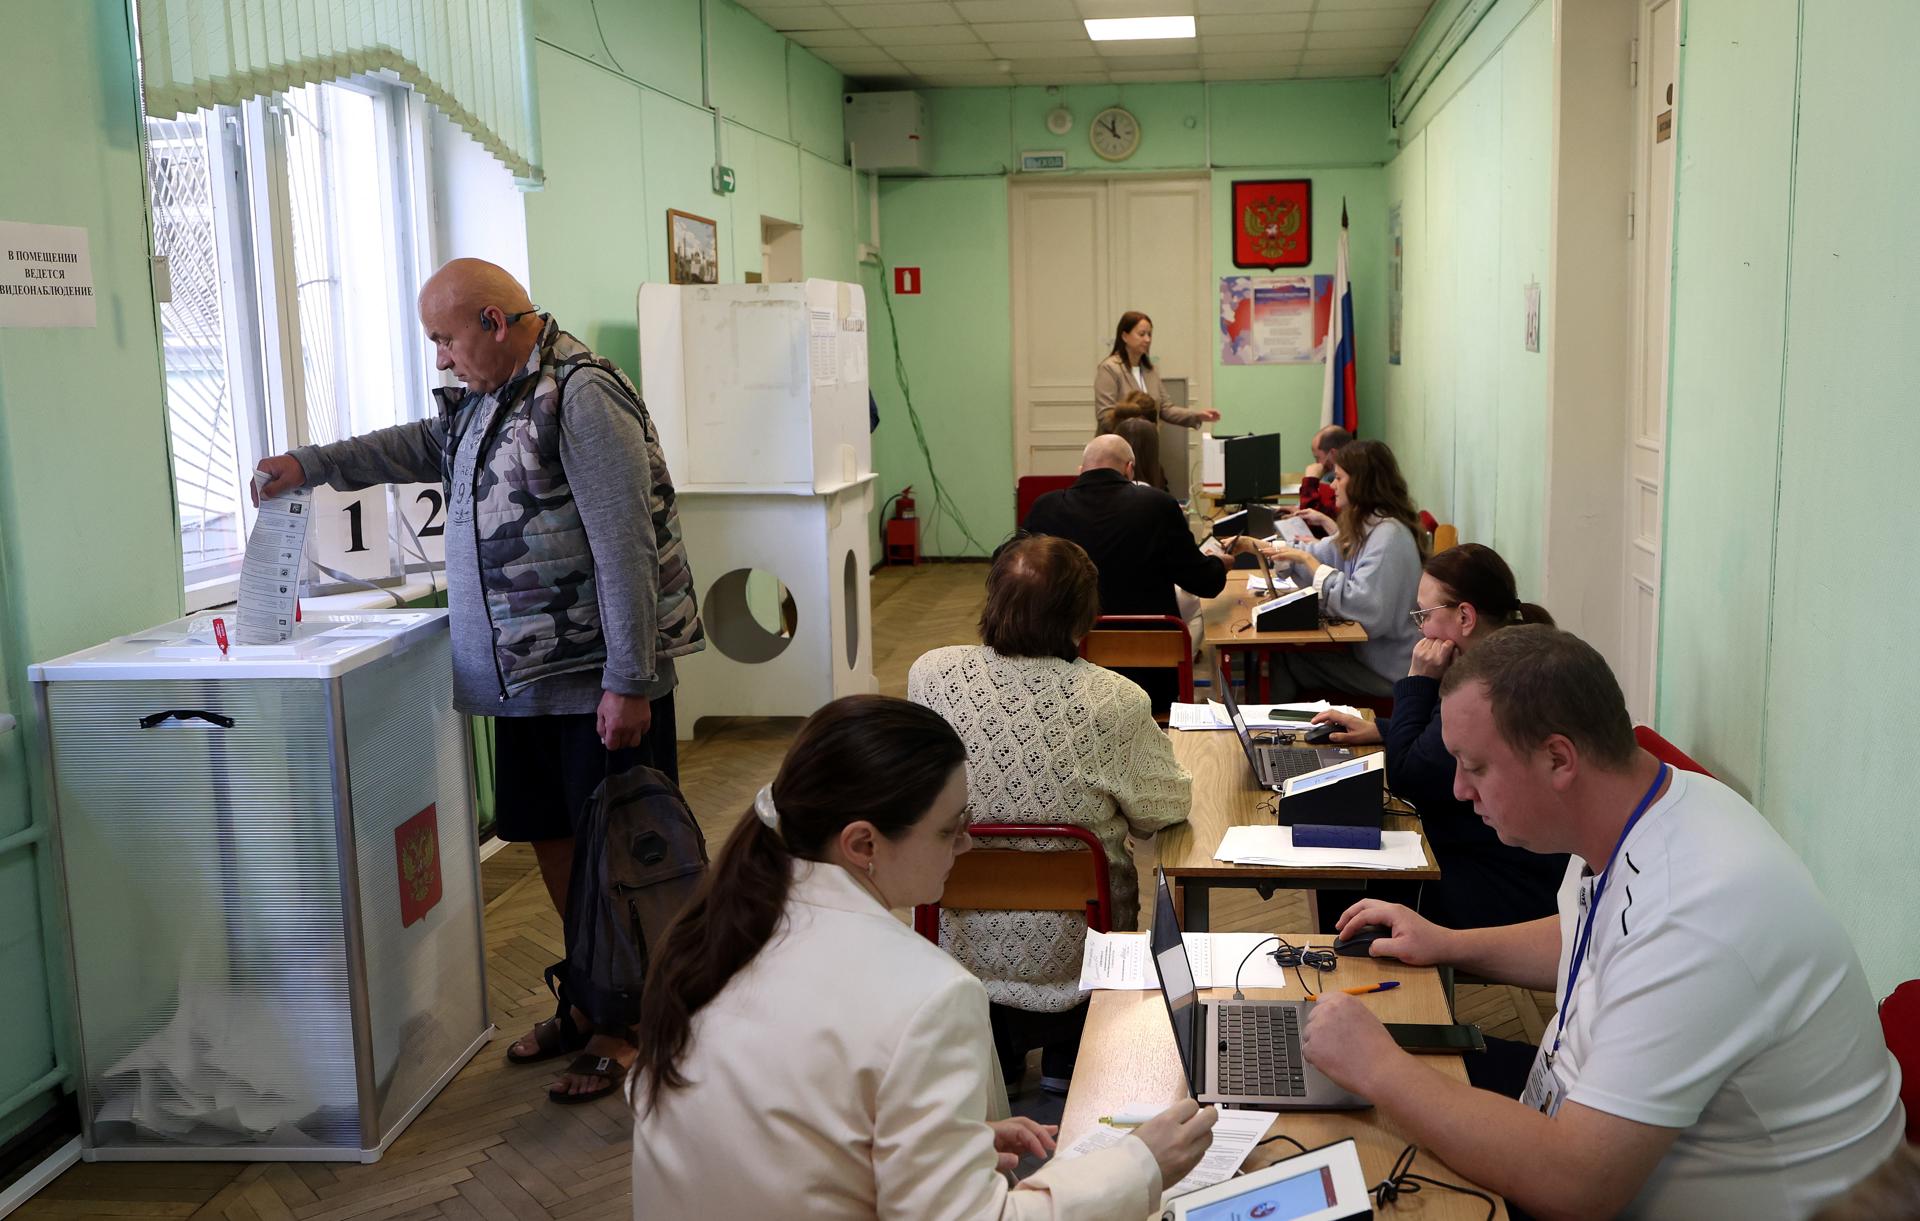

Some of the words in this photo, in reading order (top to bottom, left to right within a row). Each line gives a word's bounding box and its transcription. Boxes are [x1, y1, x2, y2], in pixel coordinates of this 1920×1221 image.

[8, 250, 14, 261] В
[16, 251, 78, 263] ПОМЕЩЕНИИ
[25, 269, 65, 279] ВЕДЕТСЯ
[0, 285, 93, 296] ВИДЕОНАБЛЮДЕНИЕ
[416, 489, 445, 537] 2
[342, 500, 370, 553] 1
